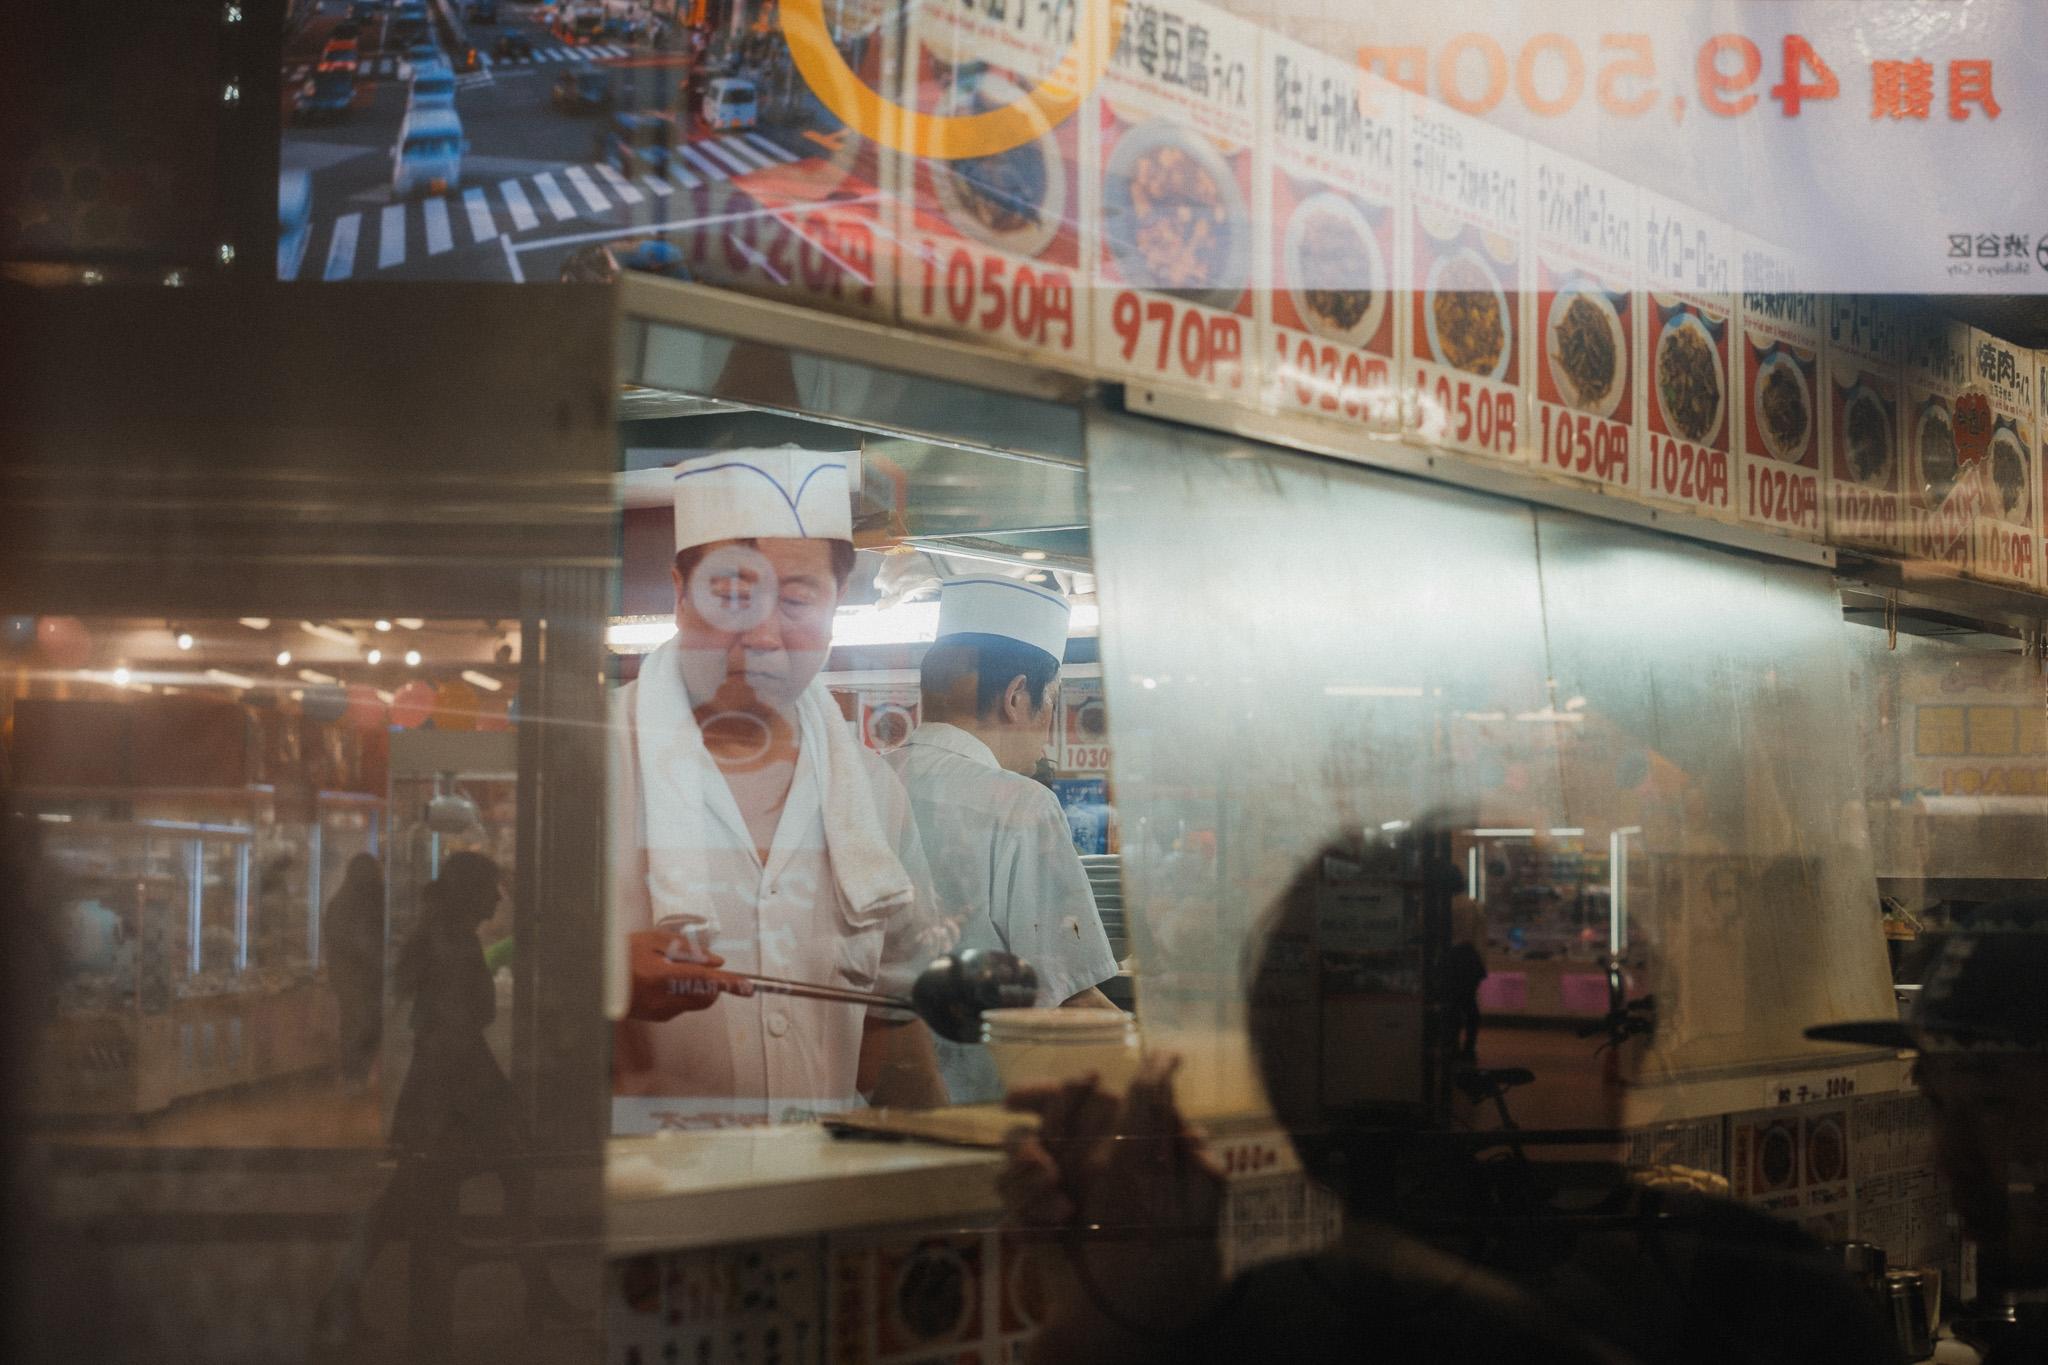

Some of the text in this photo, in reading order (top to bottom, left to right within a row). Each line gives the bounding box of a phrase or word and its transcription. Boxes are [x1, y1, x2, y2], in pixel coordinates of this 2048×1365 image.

[922, 240, 1073, 349] 1050円
[1113, 291, 1241, 388] 970円
[1541, 405, 1629, 485] 1050円
[1650, 434, 1728, 507] 1020円
[1748, 464, 1818, 529] 1020円
[1982, 524, 2032, 579] 1030円
